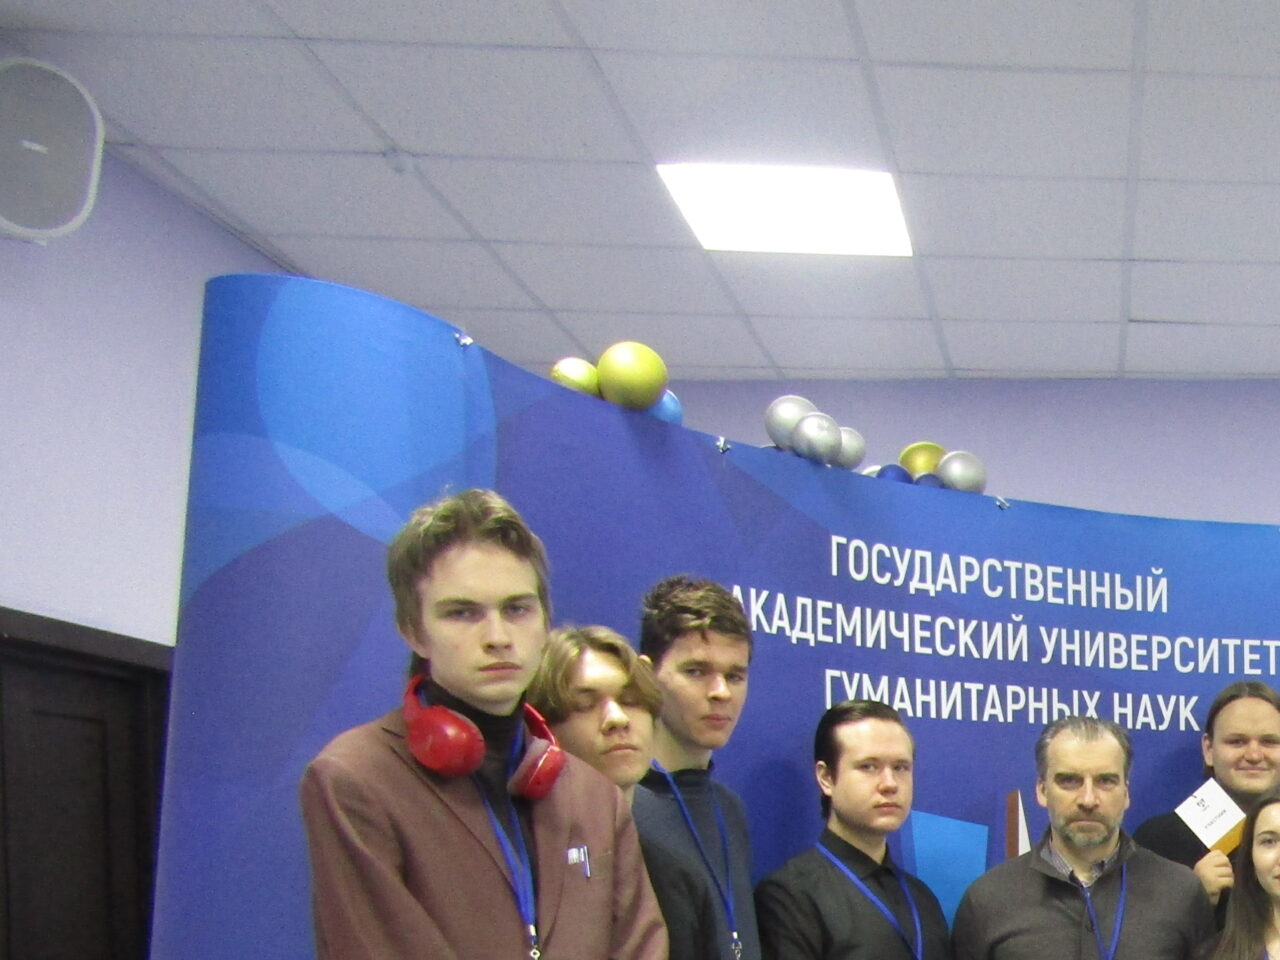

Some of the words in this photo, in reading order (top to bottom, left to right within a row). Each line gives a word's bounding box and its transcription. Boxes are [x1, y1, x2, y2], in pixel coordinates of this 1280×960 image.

[831, 534, 1168, 613] ГОСУДАРСТВЕННЫЙ
[825, 669, 1100, 725] ГУМАНИТАРНЫХ
[1113, 691, 1201, 731] НАУК
